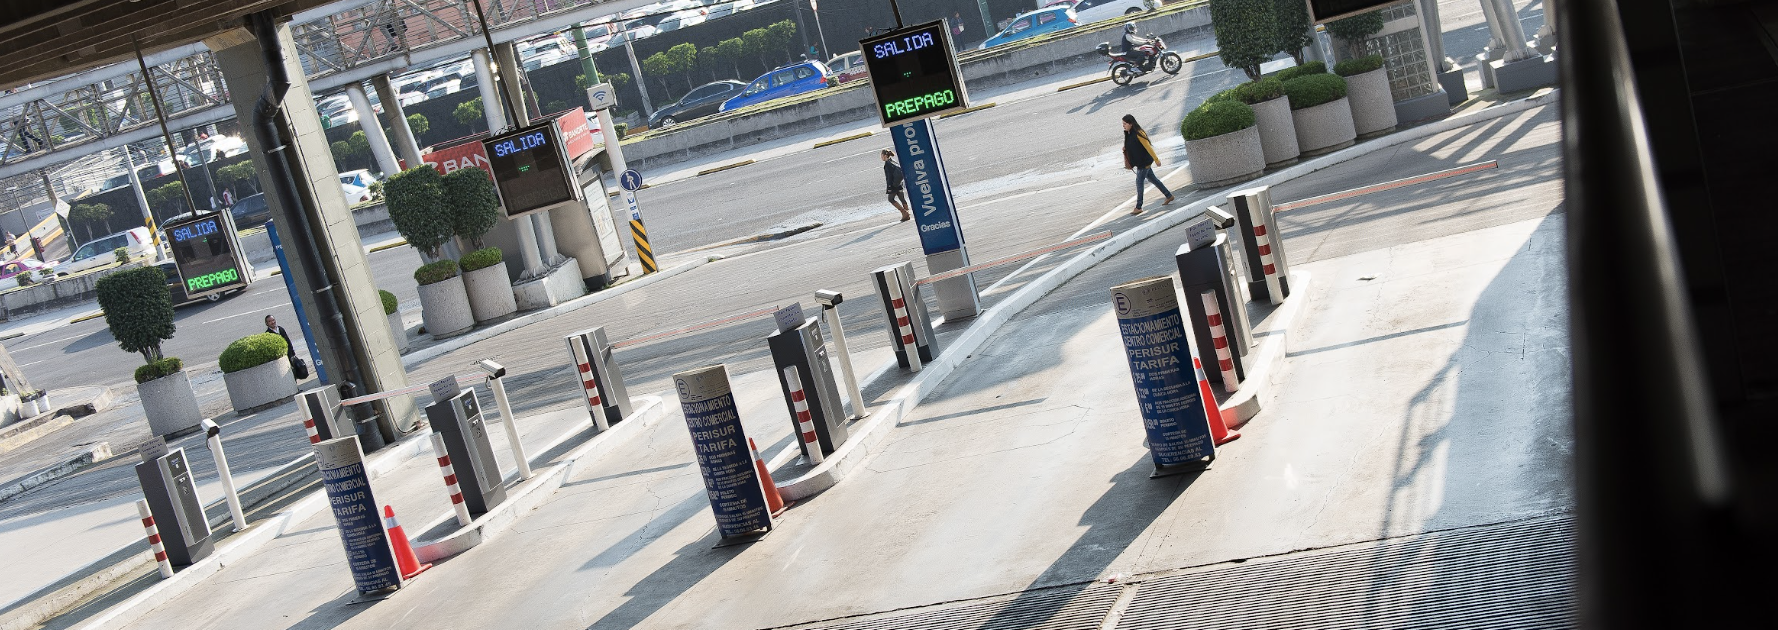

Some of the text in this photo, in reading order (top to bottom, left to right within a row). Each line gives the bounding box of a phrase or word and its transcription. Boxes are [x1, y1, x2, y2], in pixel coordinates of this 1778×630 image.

[874, 32, 934, 59] SALIDA
[885, 89, 954, 118] PREPAGO
[494, 132, 546, 157] SALIDA
[914, 159, 936, 217] Vuelva
[174, 220, 218, 242] SALIDA
[920, 221, 951, 233] Gracias
[187, 268, 238, 291] PREPAGO
[1116, 296, 1127, 311] E
[1121, 314, 1179, 335] ESTACIONAMIENTO
[1123, 327, 1182, 347] CENTRO COMERCIAL
[1129, 342, 1179, 358] PERISUR
[1133, 355, 1179, 371] TARIFA
[703, 409, 736, 426] COMERCIAL
[693, 425, 736, 441] PERISUR
[698, 438, 737, 454] TARIFA
